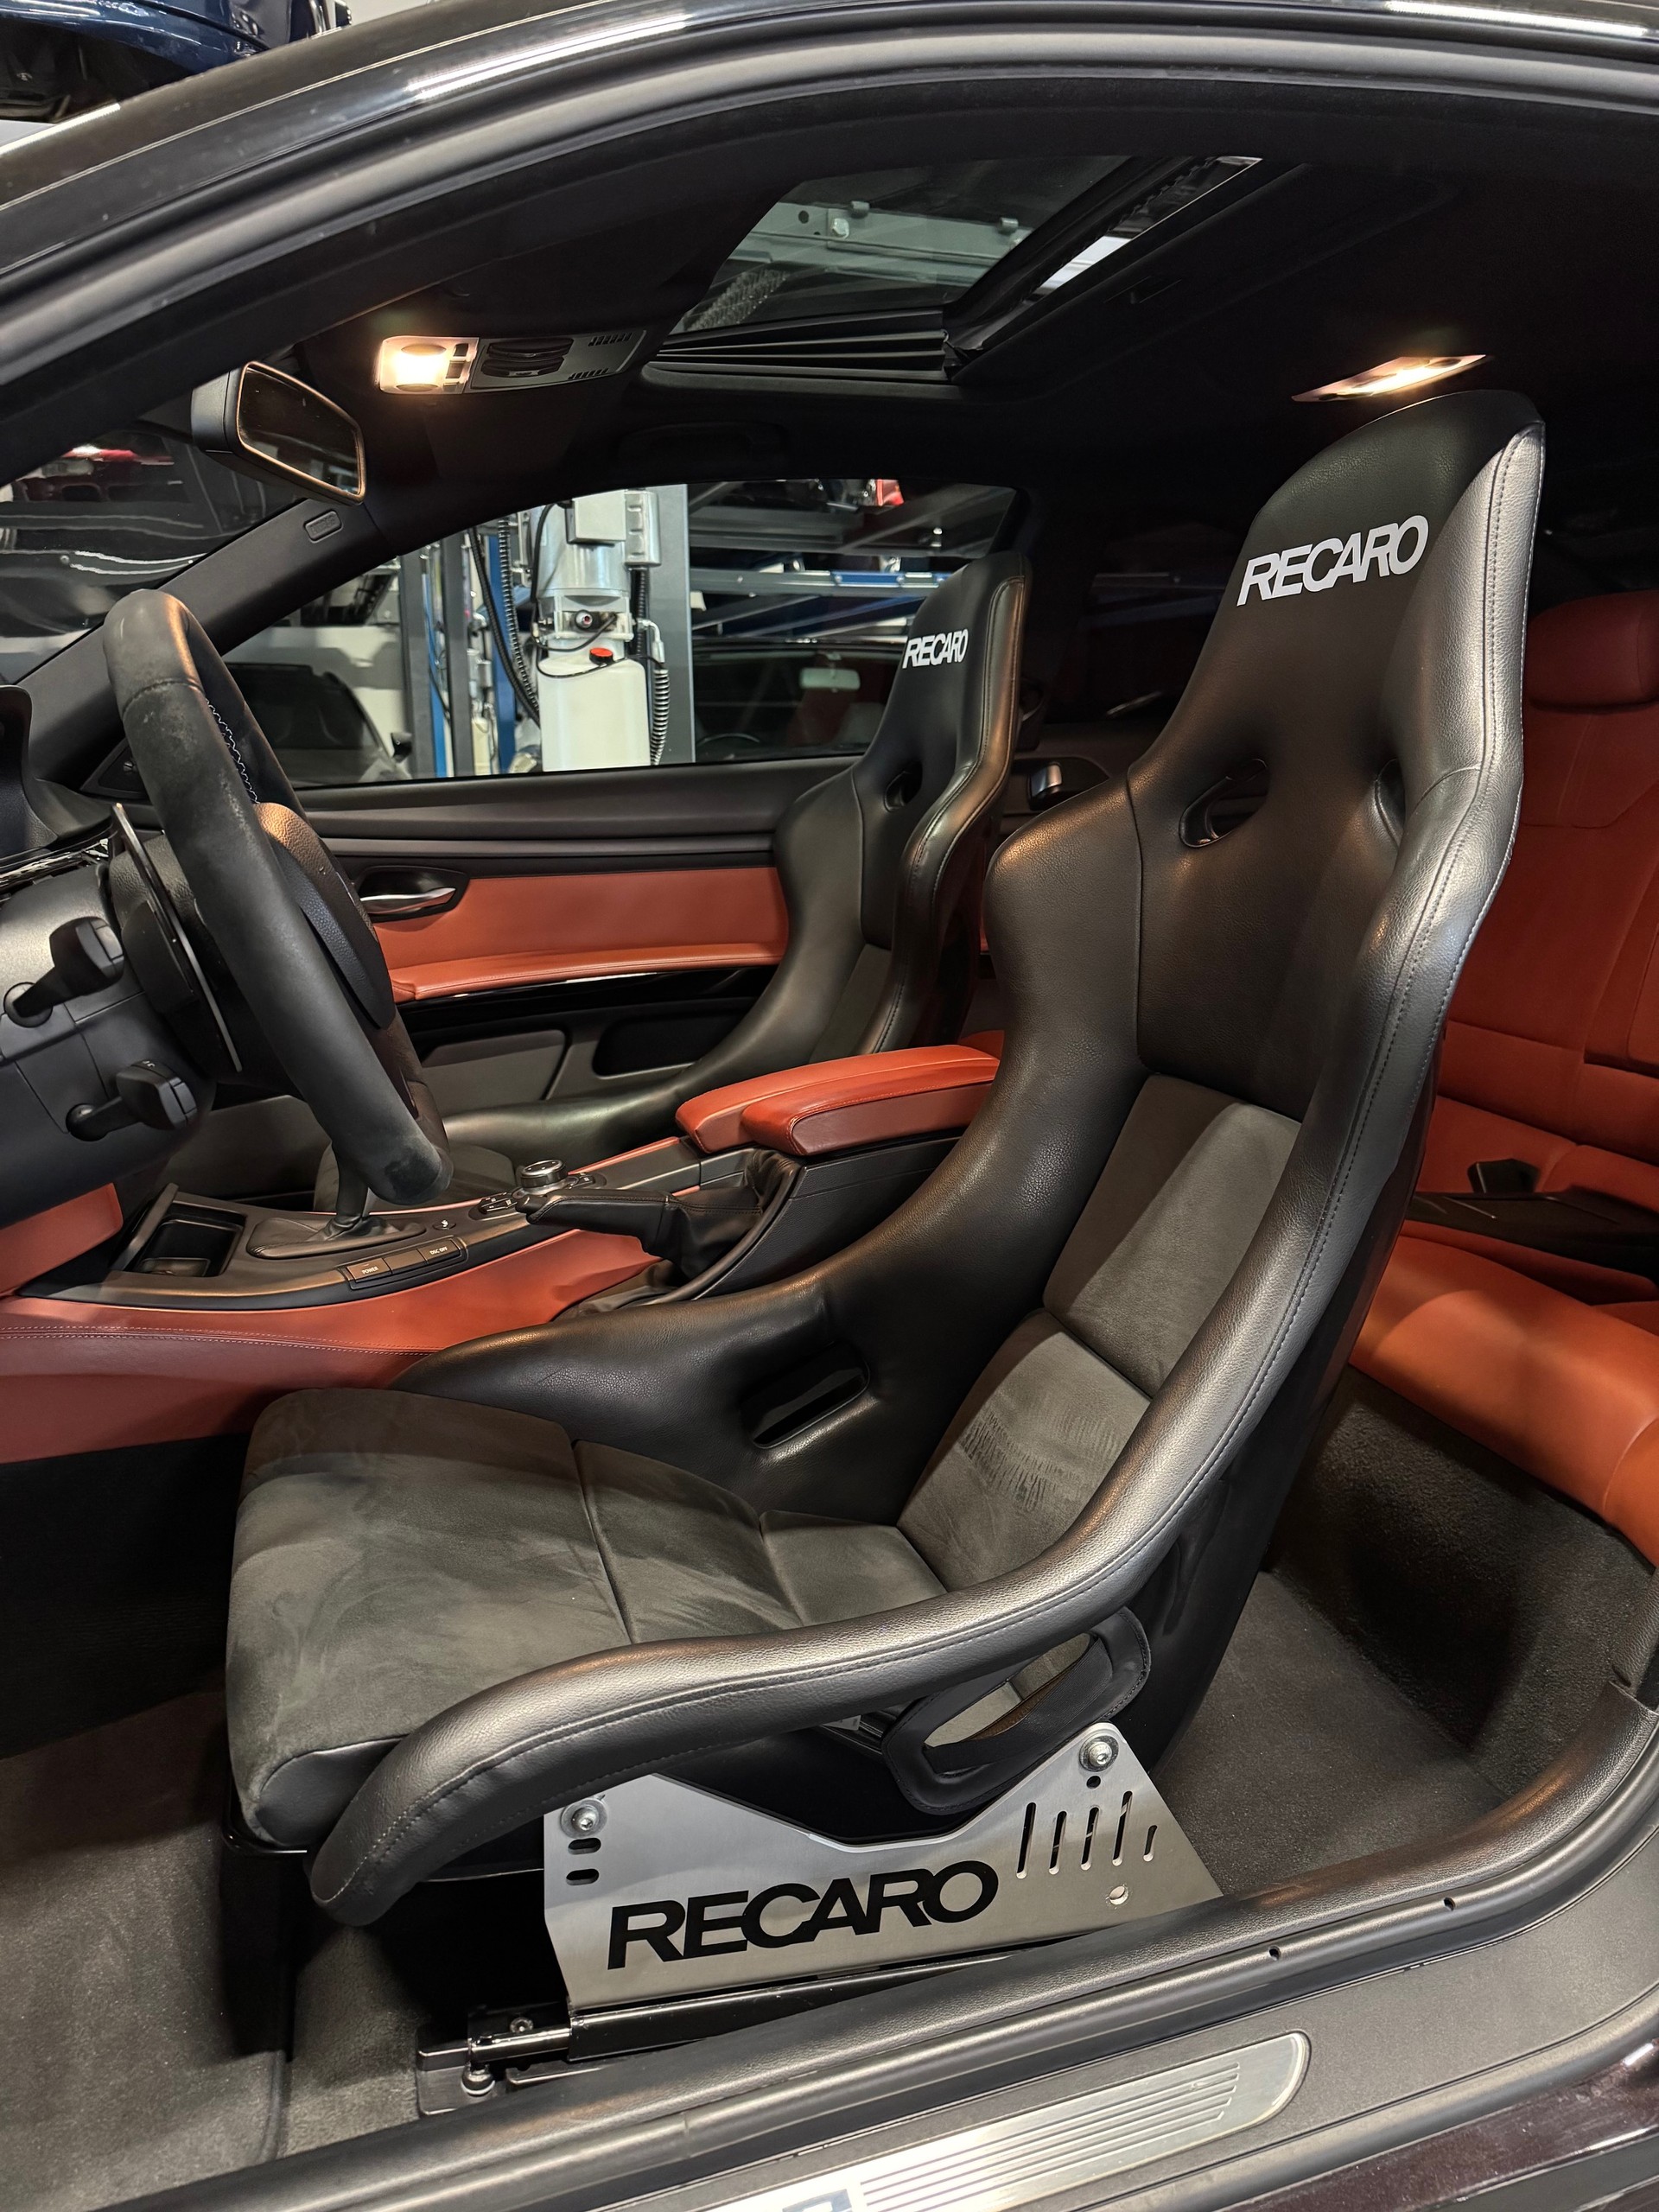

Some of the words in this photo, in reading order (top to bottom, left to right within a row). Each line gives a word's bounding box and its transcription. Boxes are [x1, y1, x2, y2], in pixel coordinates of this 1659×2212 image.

[1237, 515, 1429, 607] RECARO
[902, 628, 969, 669] RECARO
[361, 1266, 378, 1274] POWER
[607, 1860, 999, 1970] RECARO
